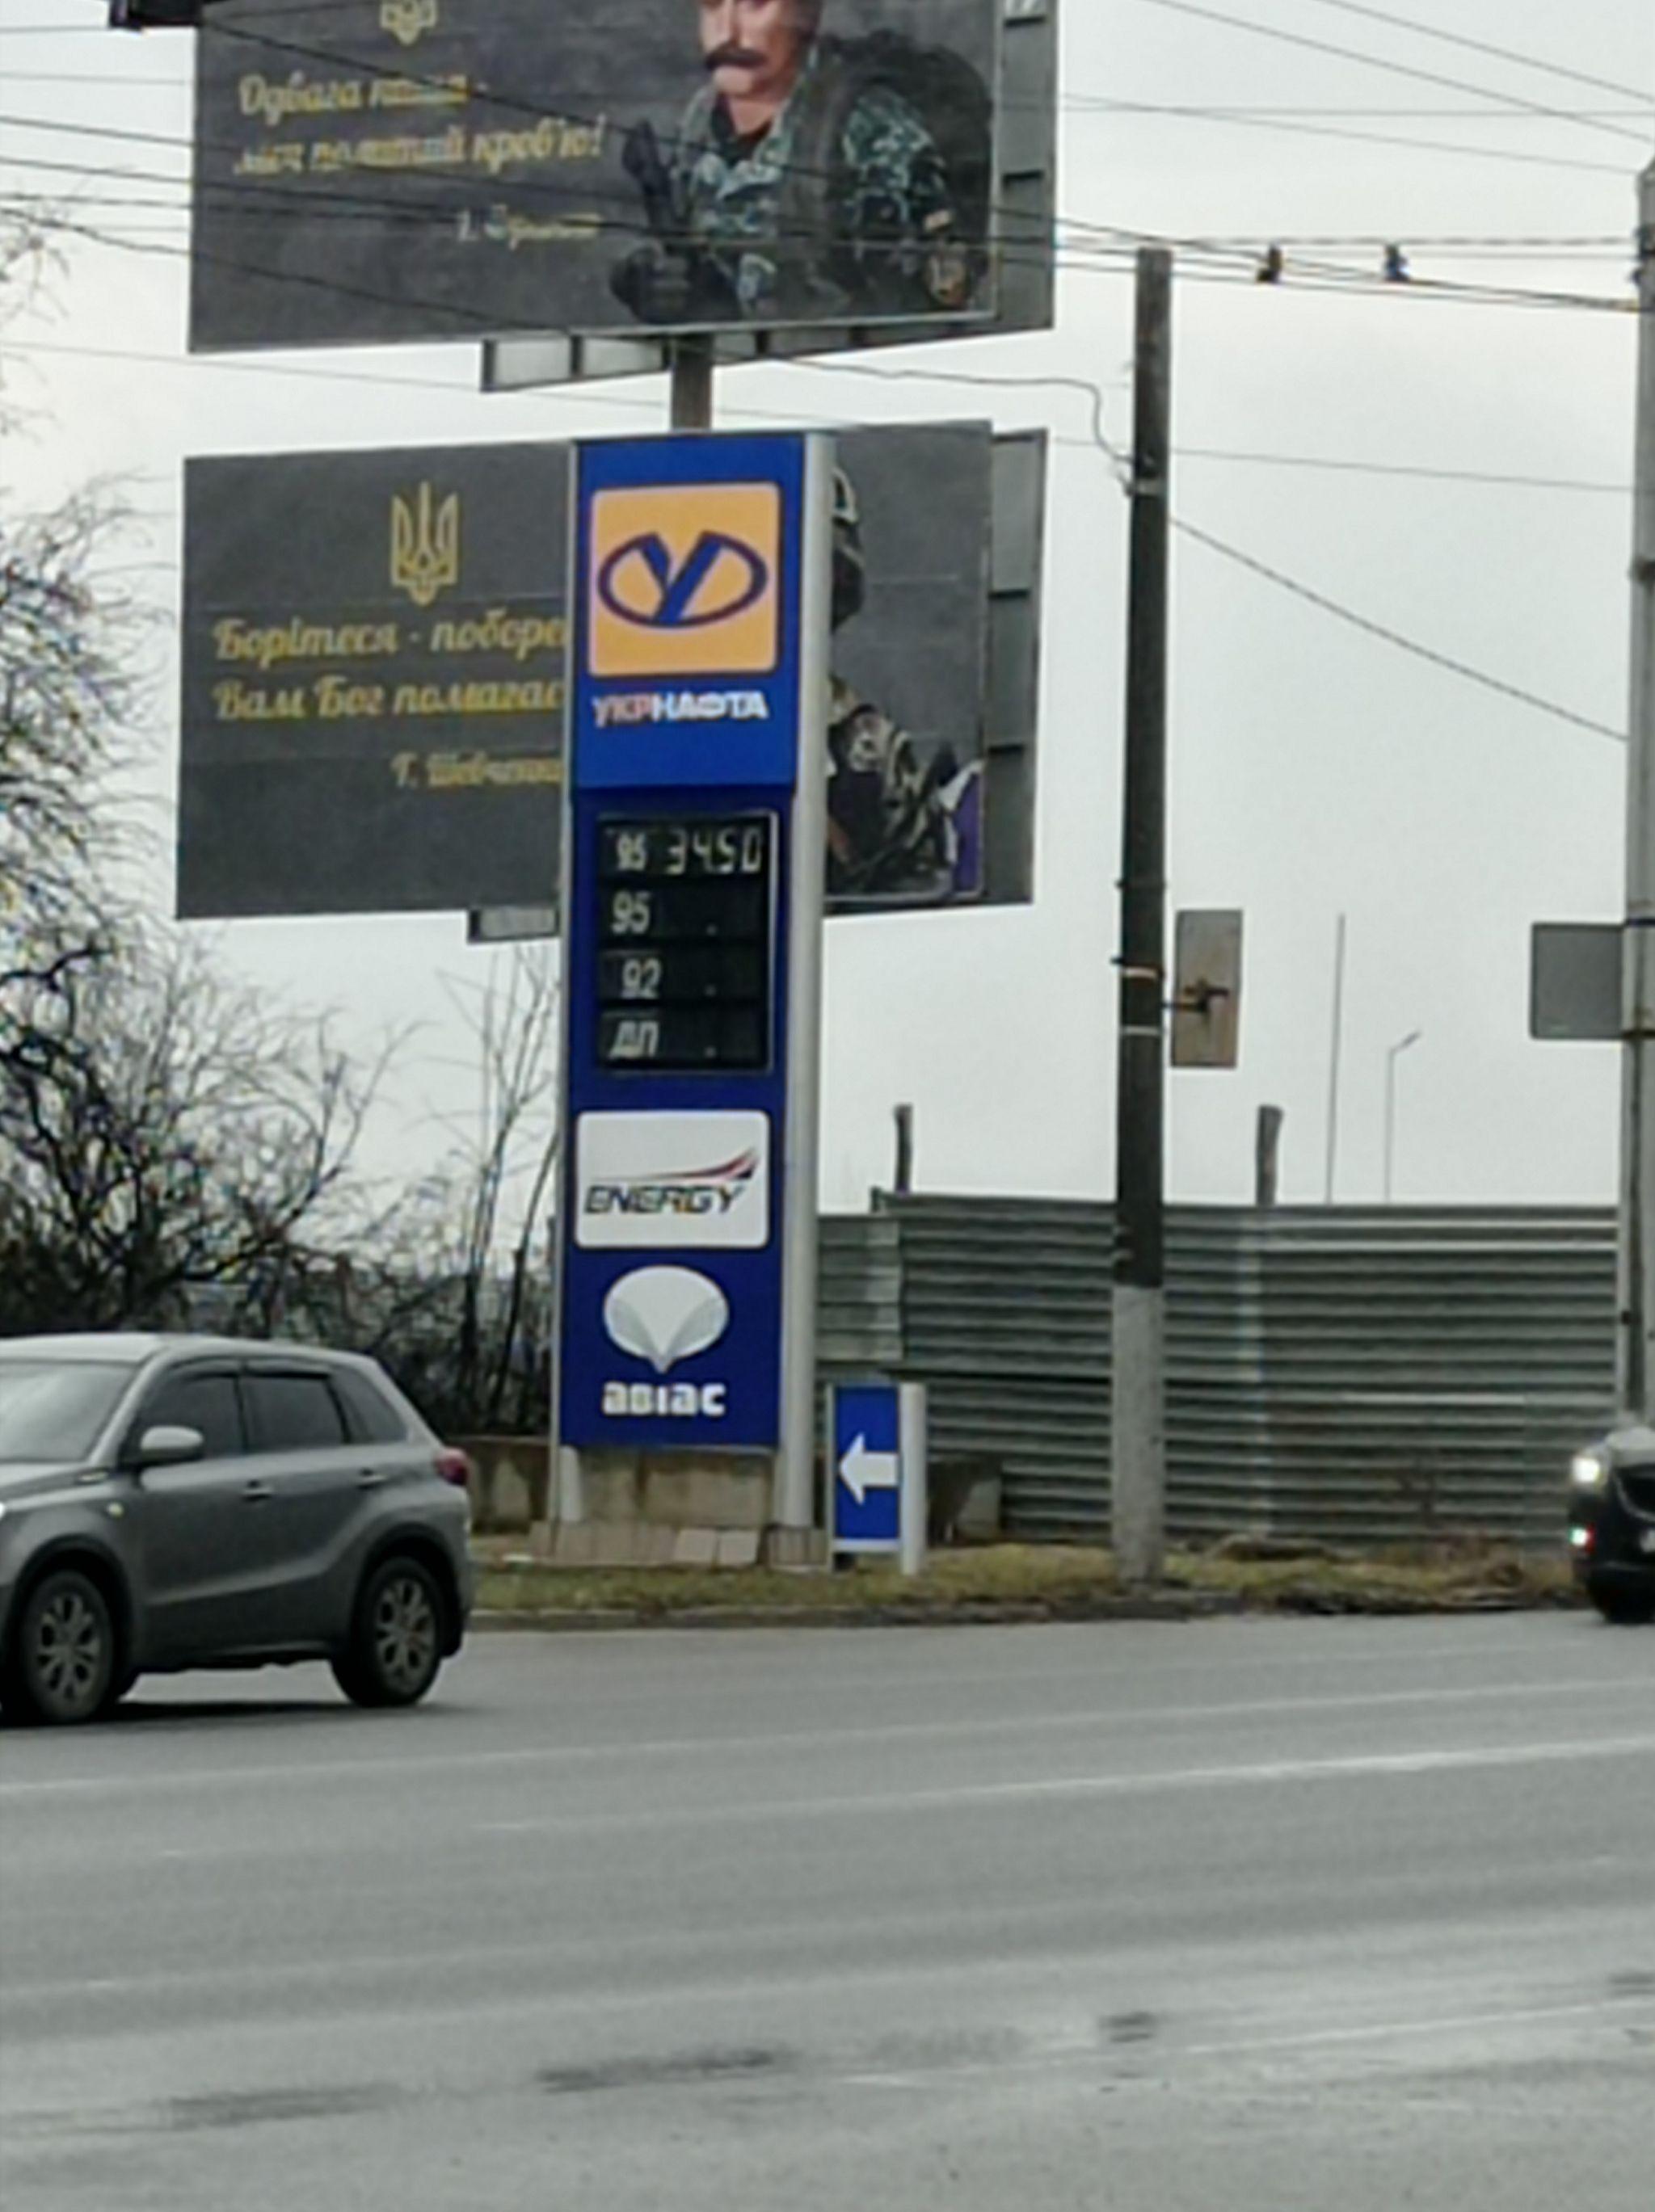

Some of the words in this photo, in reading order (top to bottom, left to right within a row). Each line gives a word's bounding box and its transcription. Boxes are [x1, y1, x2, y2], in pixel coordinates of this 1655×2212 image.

[592, 690, 769, 729] УКРНАФТА
[612, 889, 651, 935] 95
[621, 957, 662, 1000] 92
[586, 1185, 747, 1214] ENERGY
